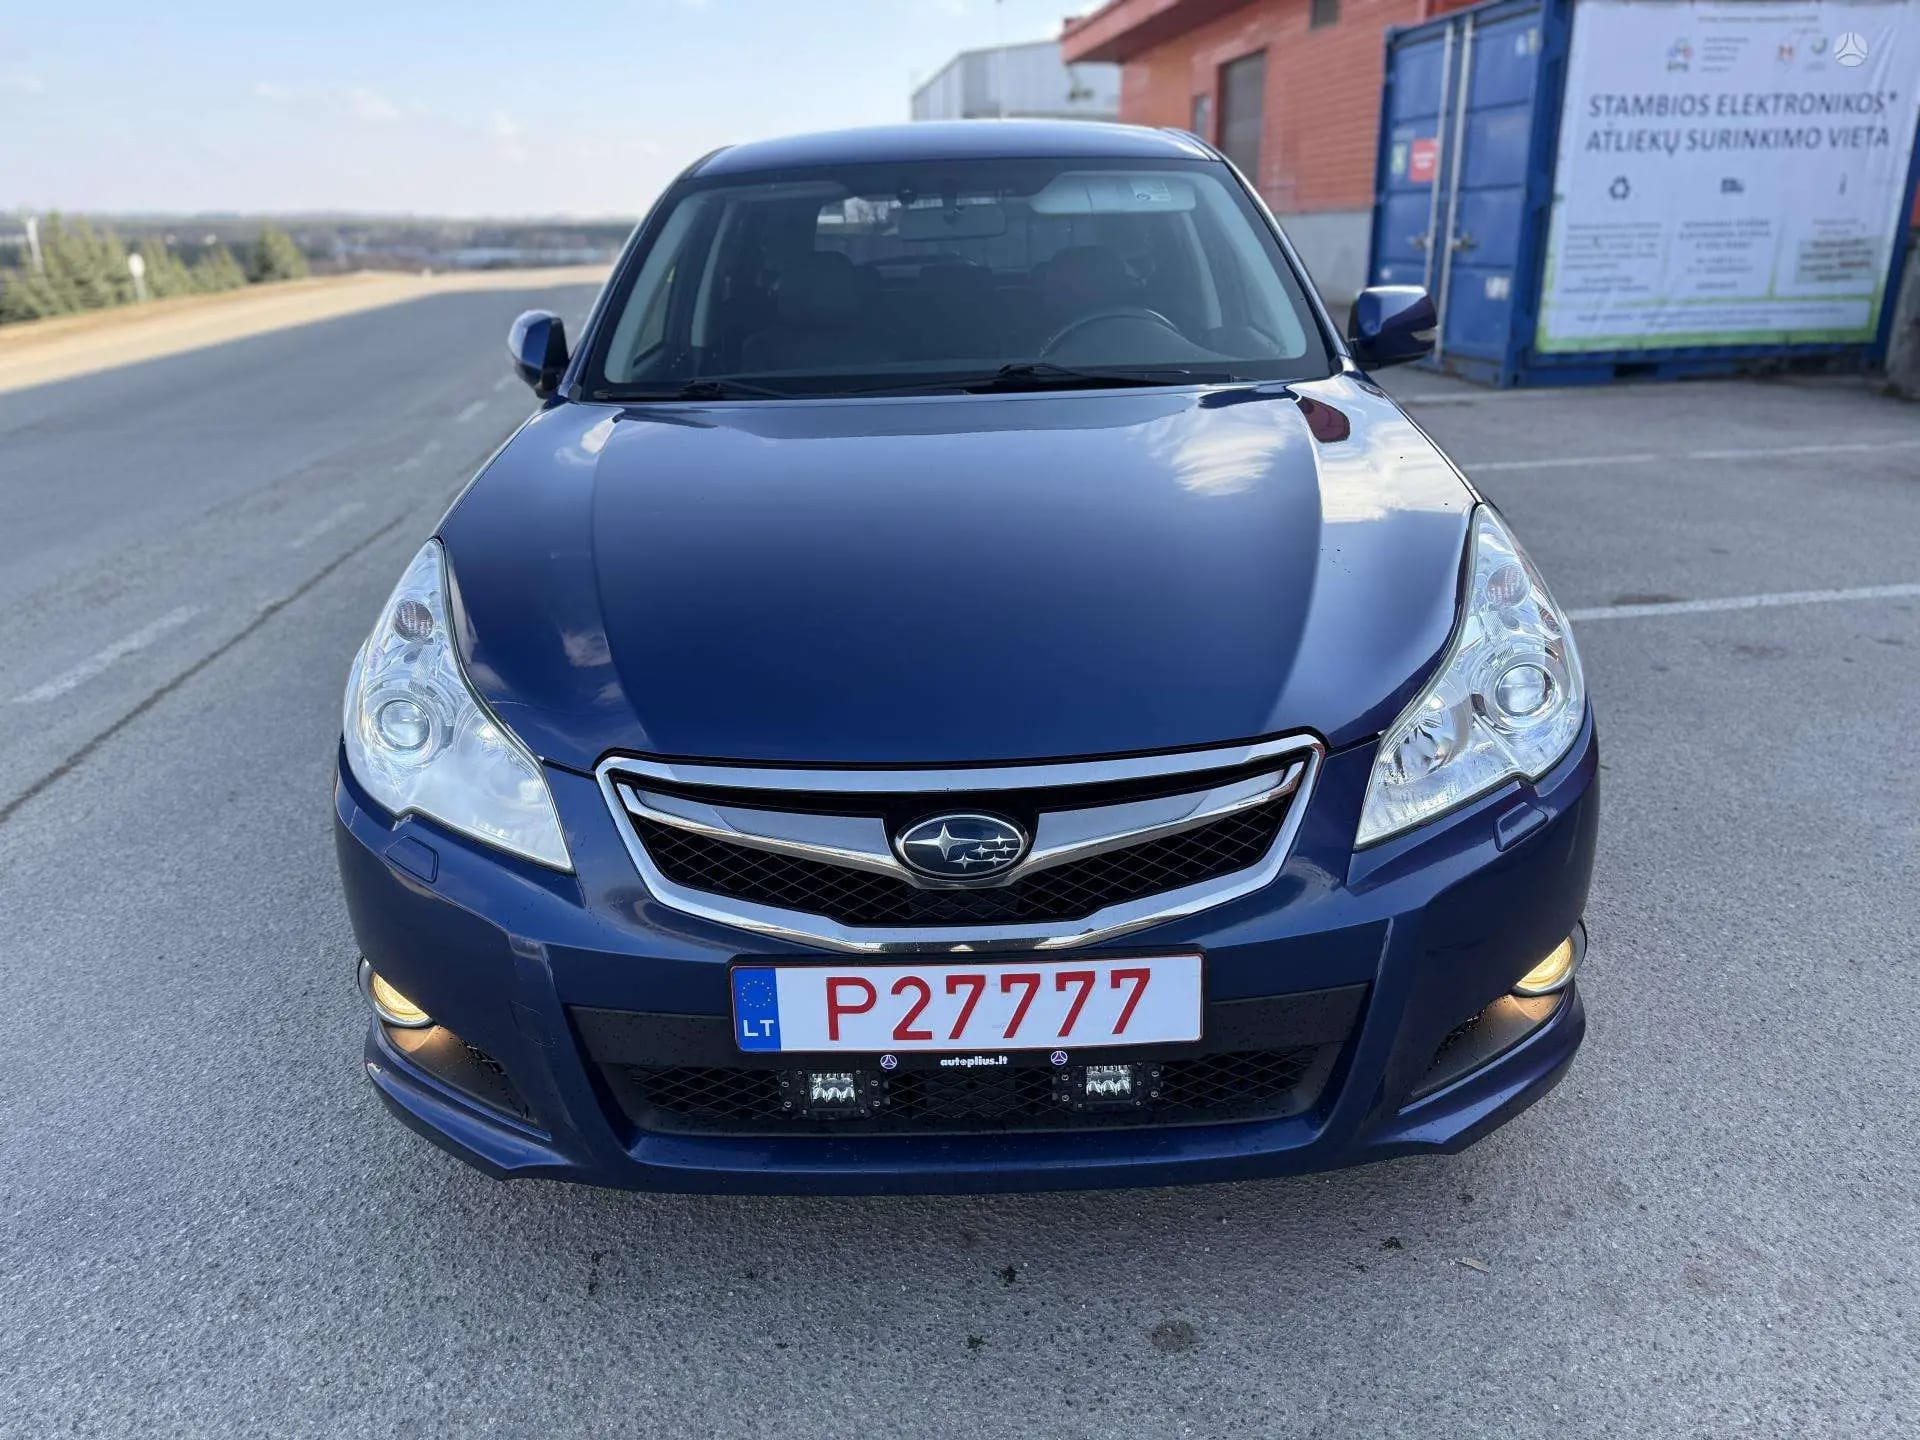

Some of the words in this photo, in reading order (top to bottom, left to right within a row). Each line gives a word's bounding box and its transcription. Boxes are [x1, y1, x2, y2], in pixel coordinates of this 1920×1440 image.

[1588, 94, 1710, 118] STAMBIOS
[1685, 127, 1822, 151] SURINKIMO
[1828, 126, 1890, 149] VIETA
[825, 967, 1151, 1042] P27777
[743, 1019, 774, 1037] LT
[940, 1055, 1008, 1068] autoplius.lt
